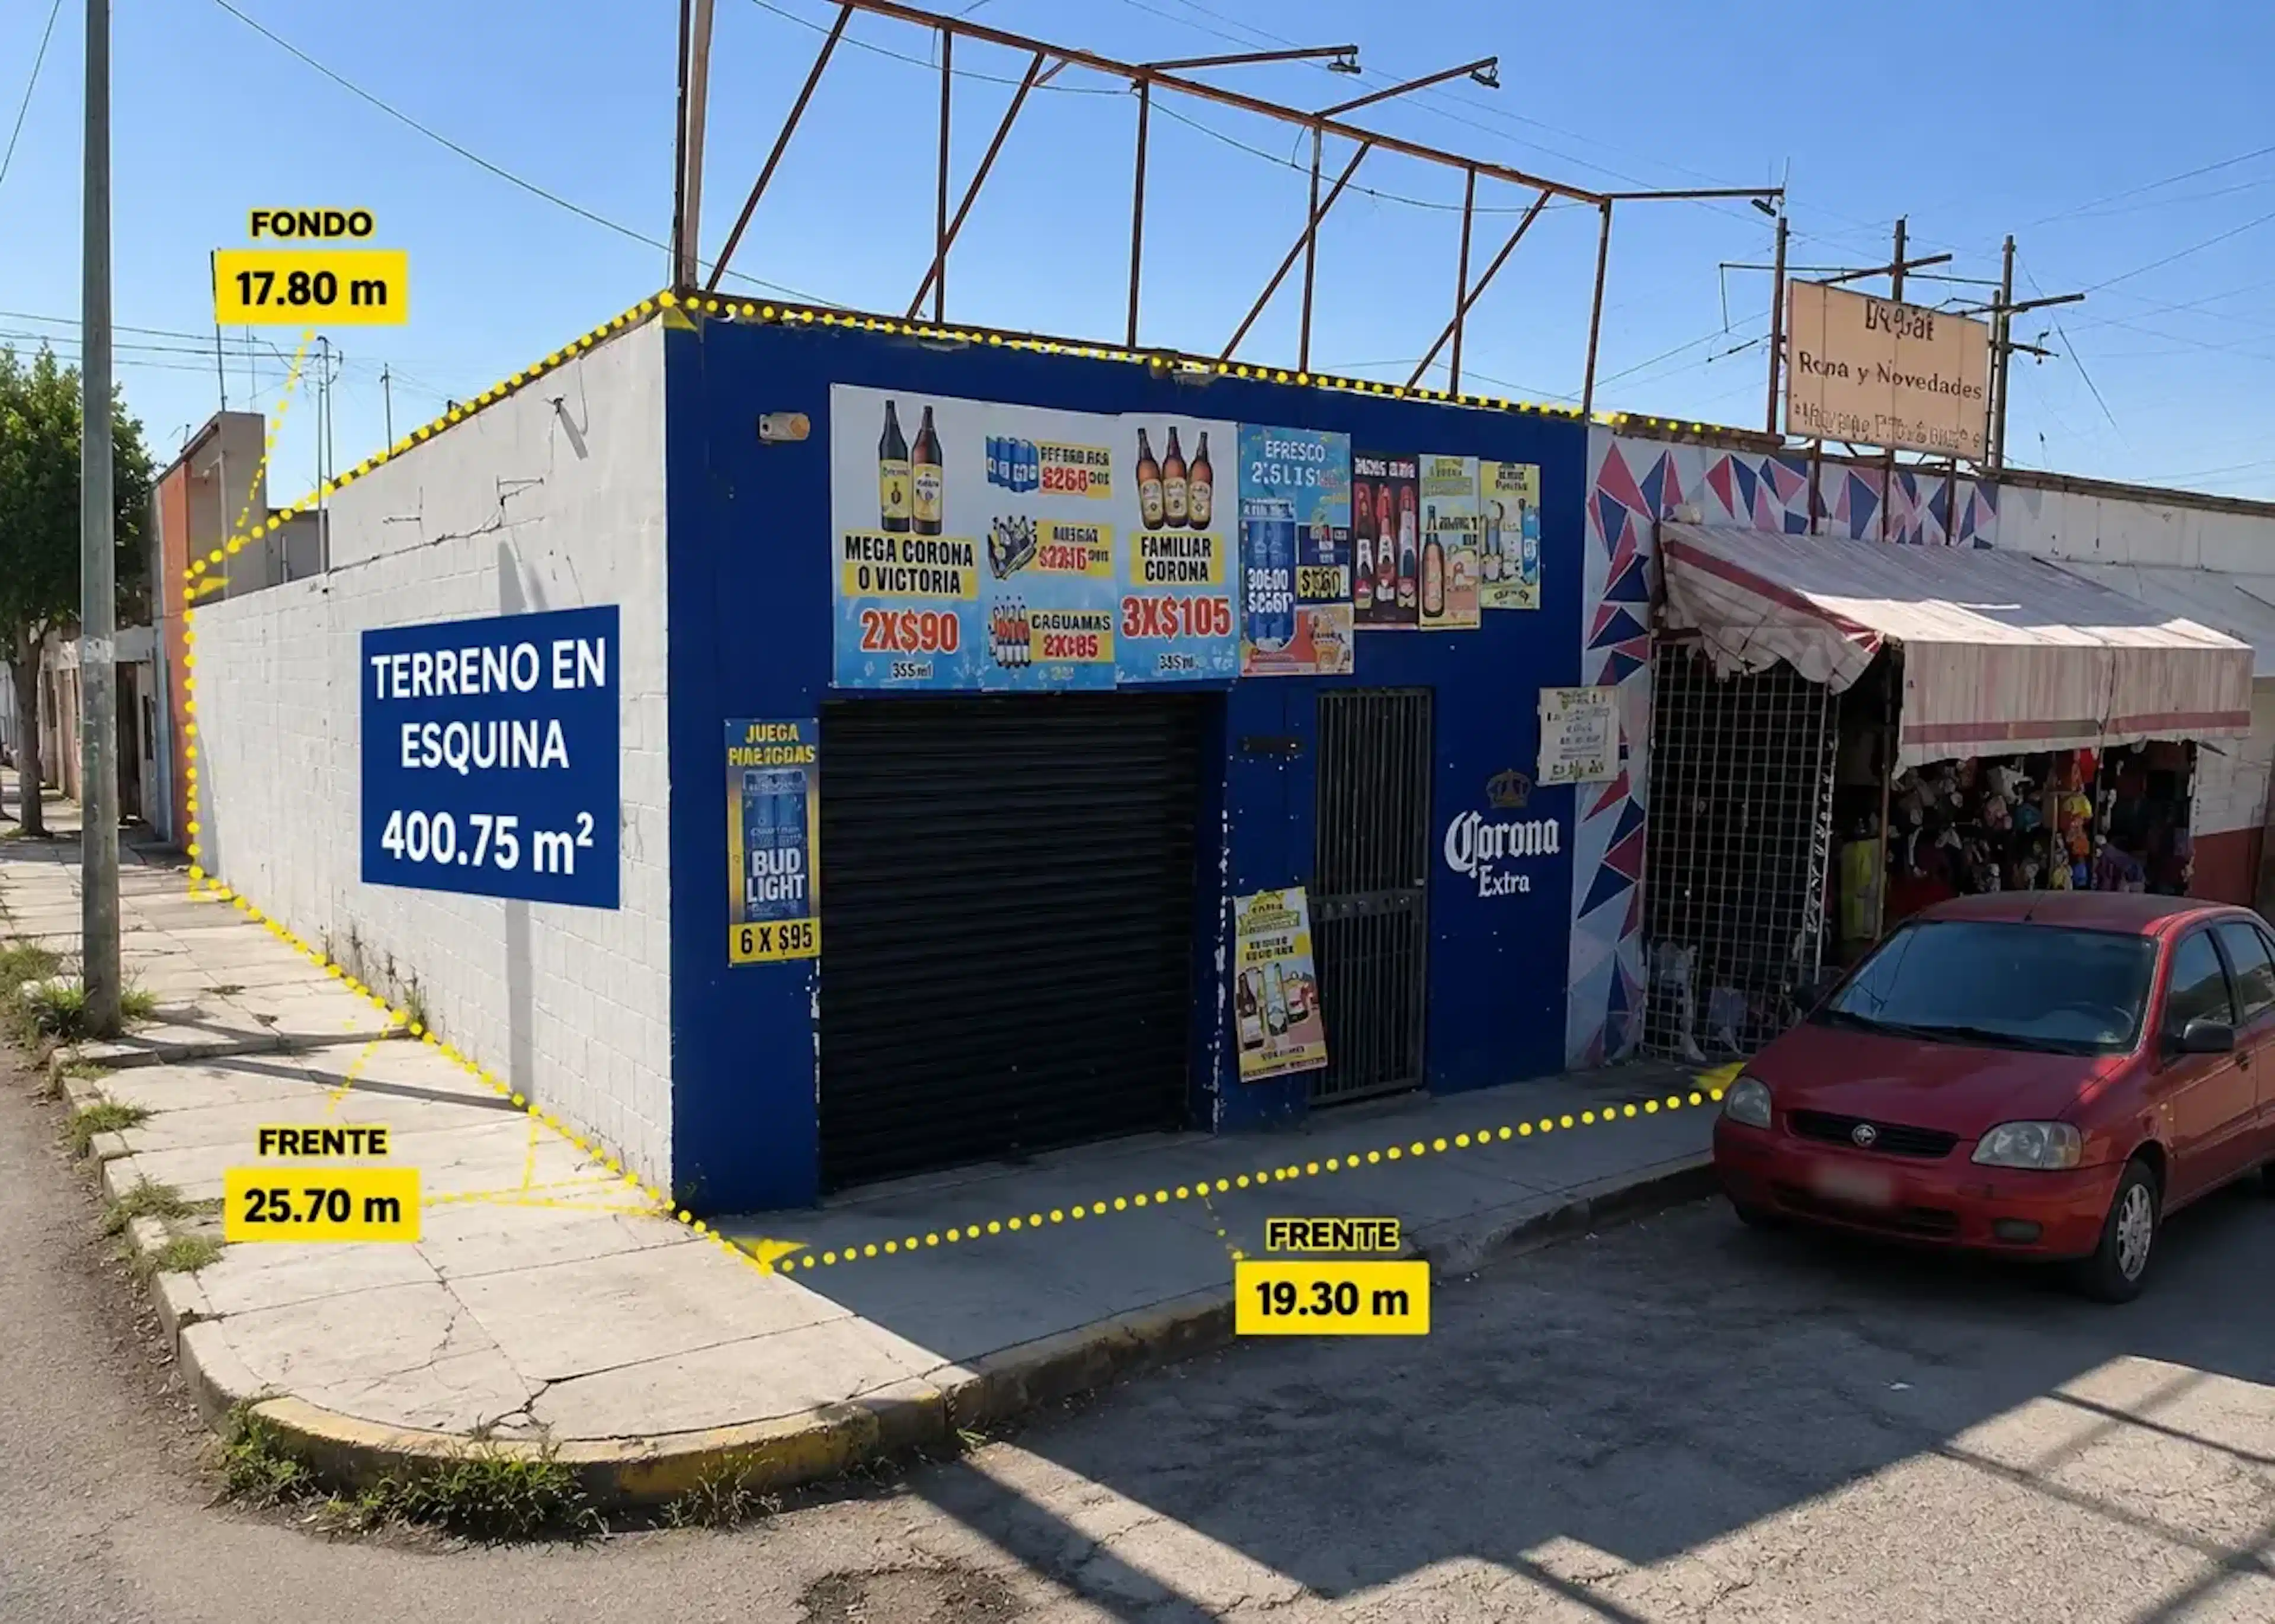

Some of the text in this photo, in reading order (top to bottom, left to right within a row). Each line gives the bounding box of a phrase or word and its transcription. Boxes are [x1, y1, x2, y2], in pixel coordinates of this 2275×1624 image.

[1857, 367, 1870, 386] y
[1877, 360, 1982, 400] Novedades
[845, 535, 974, 567] MEGA CORONA
[1141, 536, 1212, 559] FAMILIAR
[858, 566, 962, 594] O VICTORIA
[1145, 560, 1210, 583] CORONA
[860, 609, 959, 652] 2X$90
[1122, 596, 1232, 638] 3X$105
[1444, 810, 1561, 879] Corona
[751, 848, 802, 877] BUD
[746, 874, 806, 904] LIGHT
[1478, 864, 1531, 897] Extra
[741, 923, 813, 955] 6 X $95
